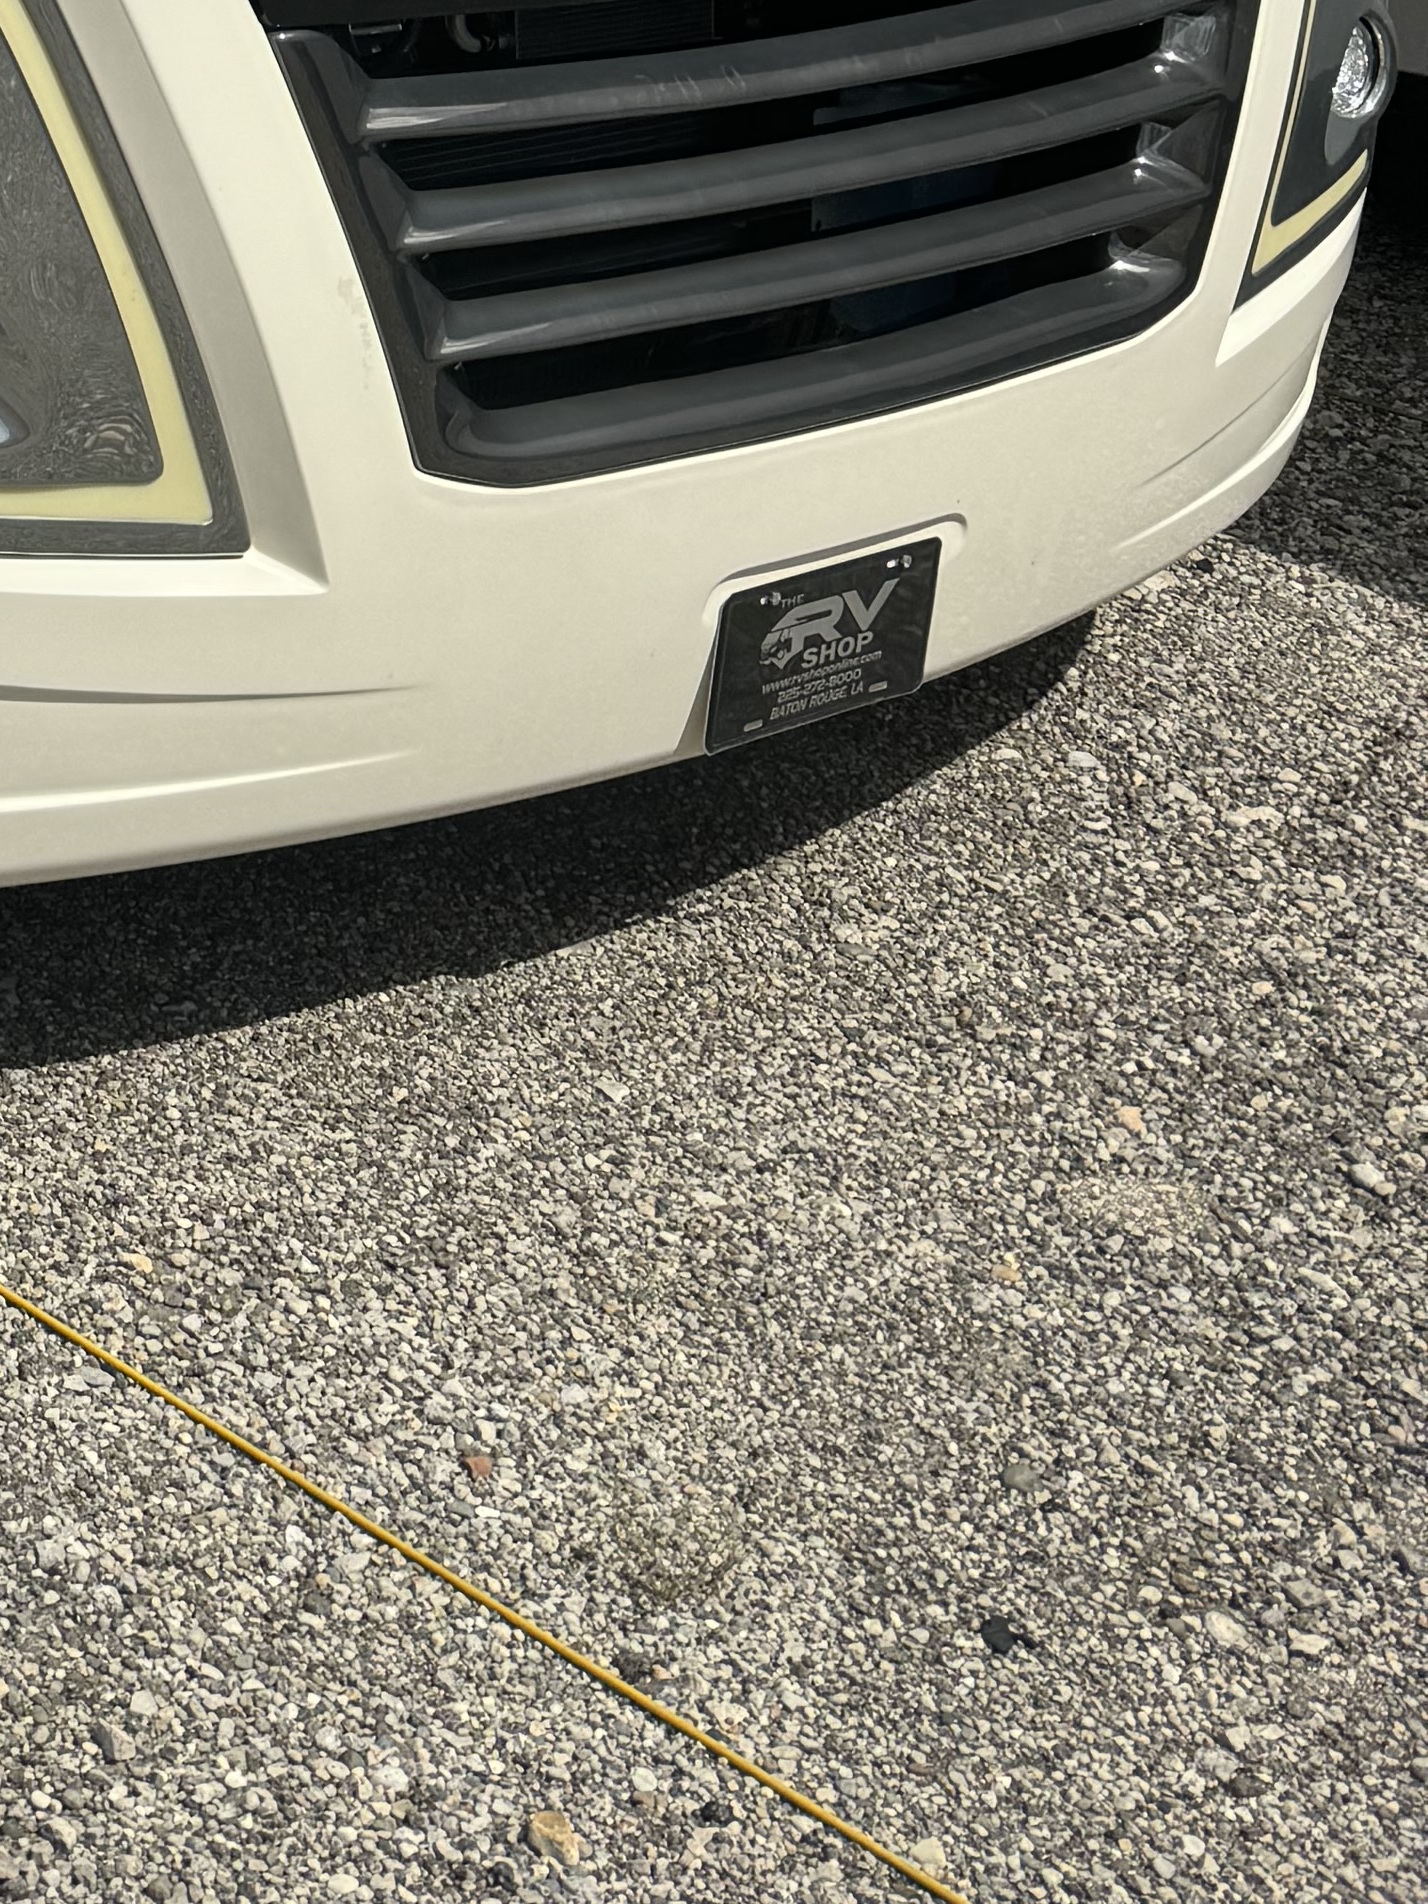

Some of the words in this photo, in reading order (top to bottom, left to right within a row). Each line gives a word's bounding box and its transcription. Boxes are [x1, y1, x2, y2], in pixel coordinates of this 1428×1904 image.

[780, 593, 805, 608] THE
[760, 577, 901, 670] RV
[801, 631, 874, 668] SHOP
[770, 698, 809, 721] BATON
[809, 686, 848, 708] ROUGE
[851, 680, 864, 695] LA
